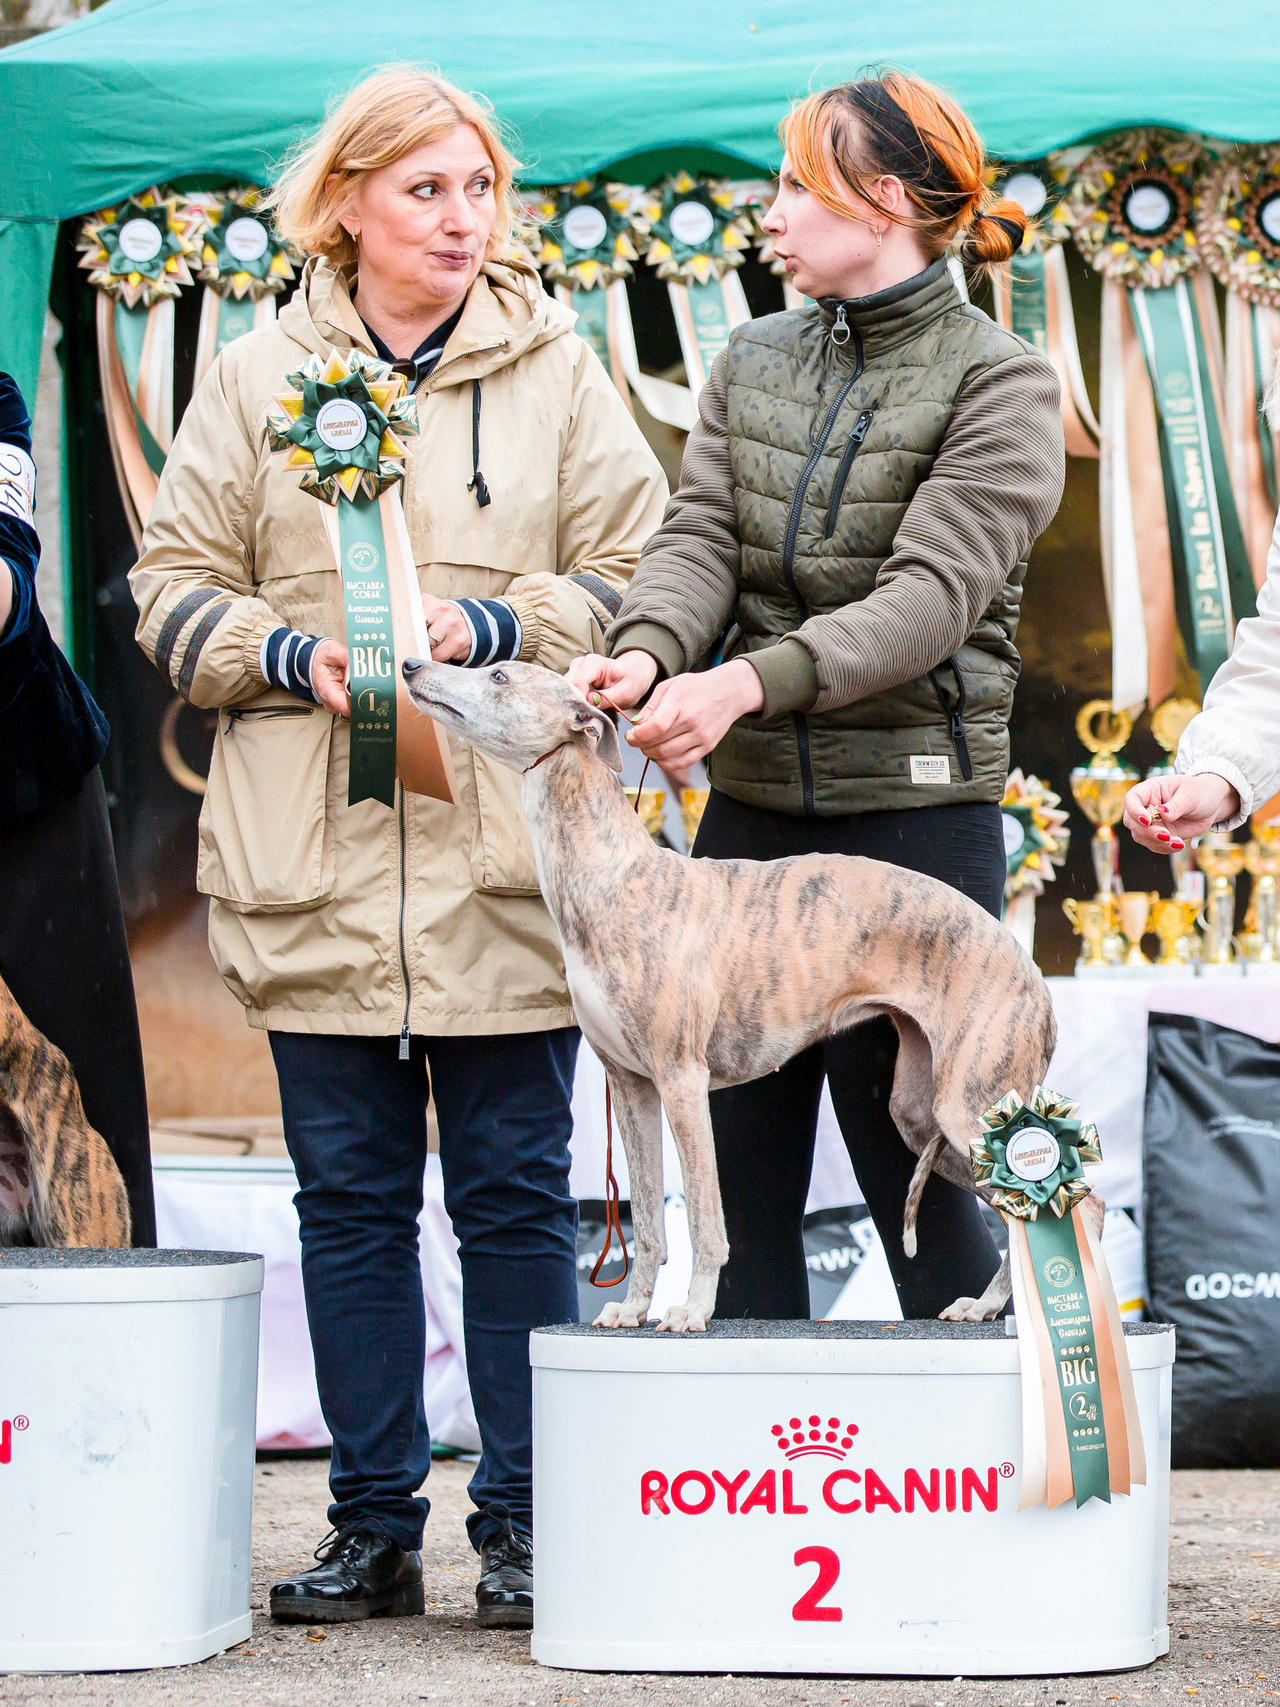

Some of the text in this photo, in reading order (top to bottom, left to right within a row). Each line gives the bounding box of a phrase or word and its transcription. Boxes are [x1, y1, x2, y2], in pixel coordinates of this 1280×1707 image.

[346, 581, 385, 590] ВЫСТАВКА
[353, 590, 381, 599] СОБАК
[352, 646, 391, 677] BIG
[368, 692, 375, 711] 1
[1046, 1292, 1084, 1305] ВЫСТАВКА
[1054, 1301, 1080, 1312] СОБАК
[1060, 1358, 1096, 1387] BIG
[1076, 1396, 1087, 1415] 2
[640, 1468, 808, 1515] ROYAL
[792, 1545, 843, 1622] 2
